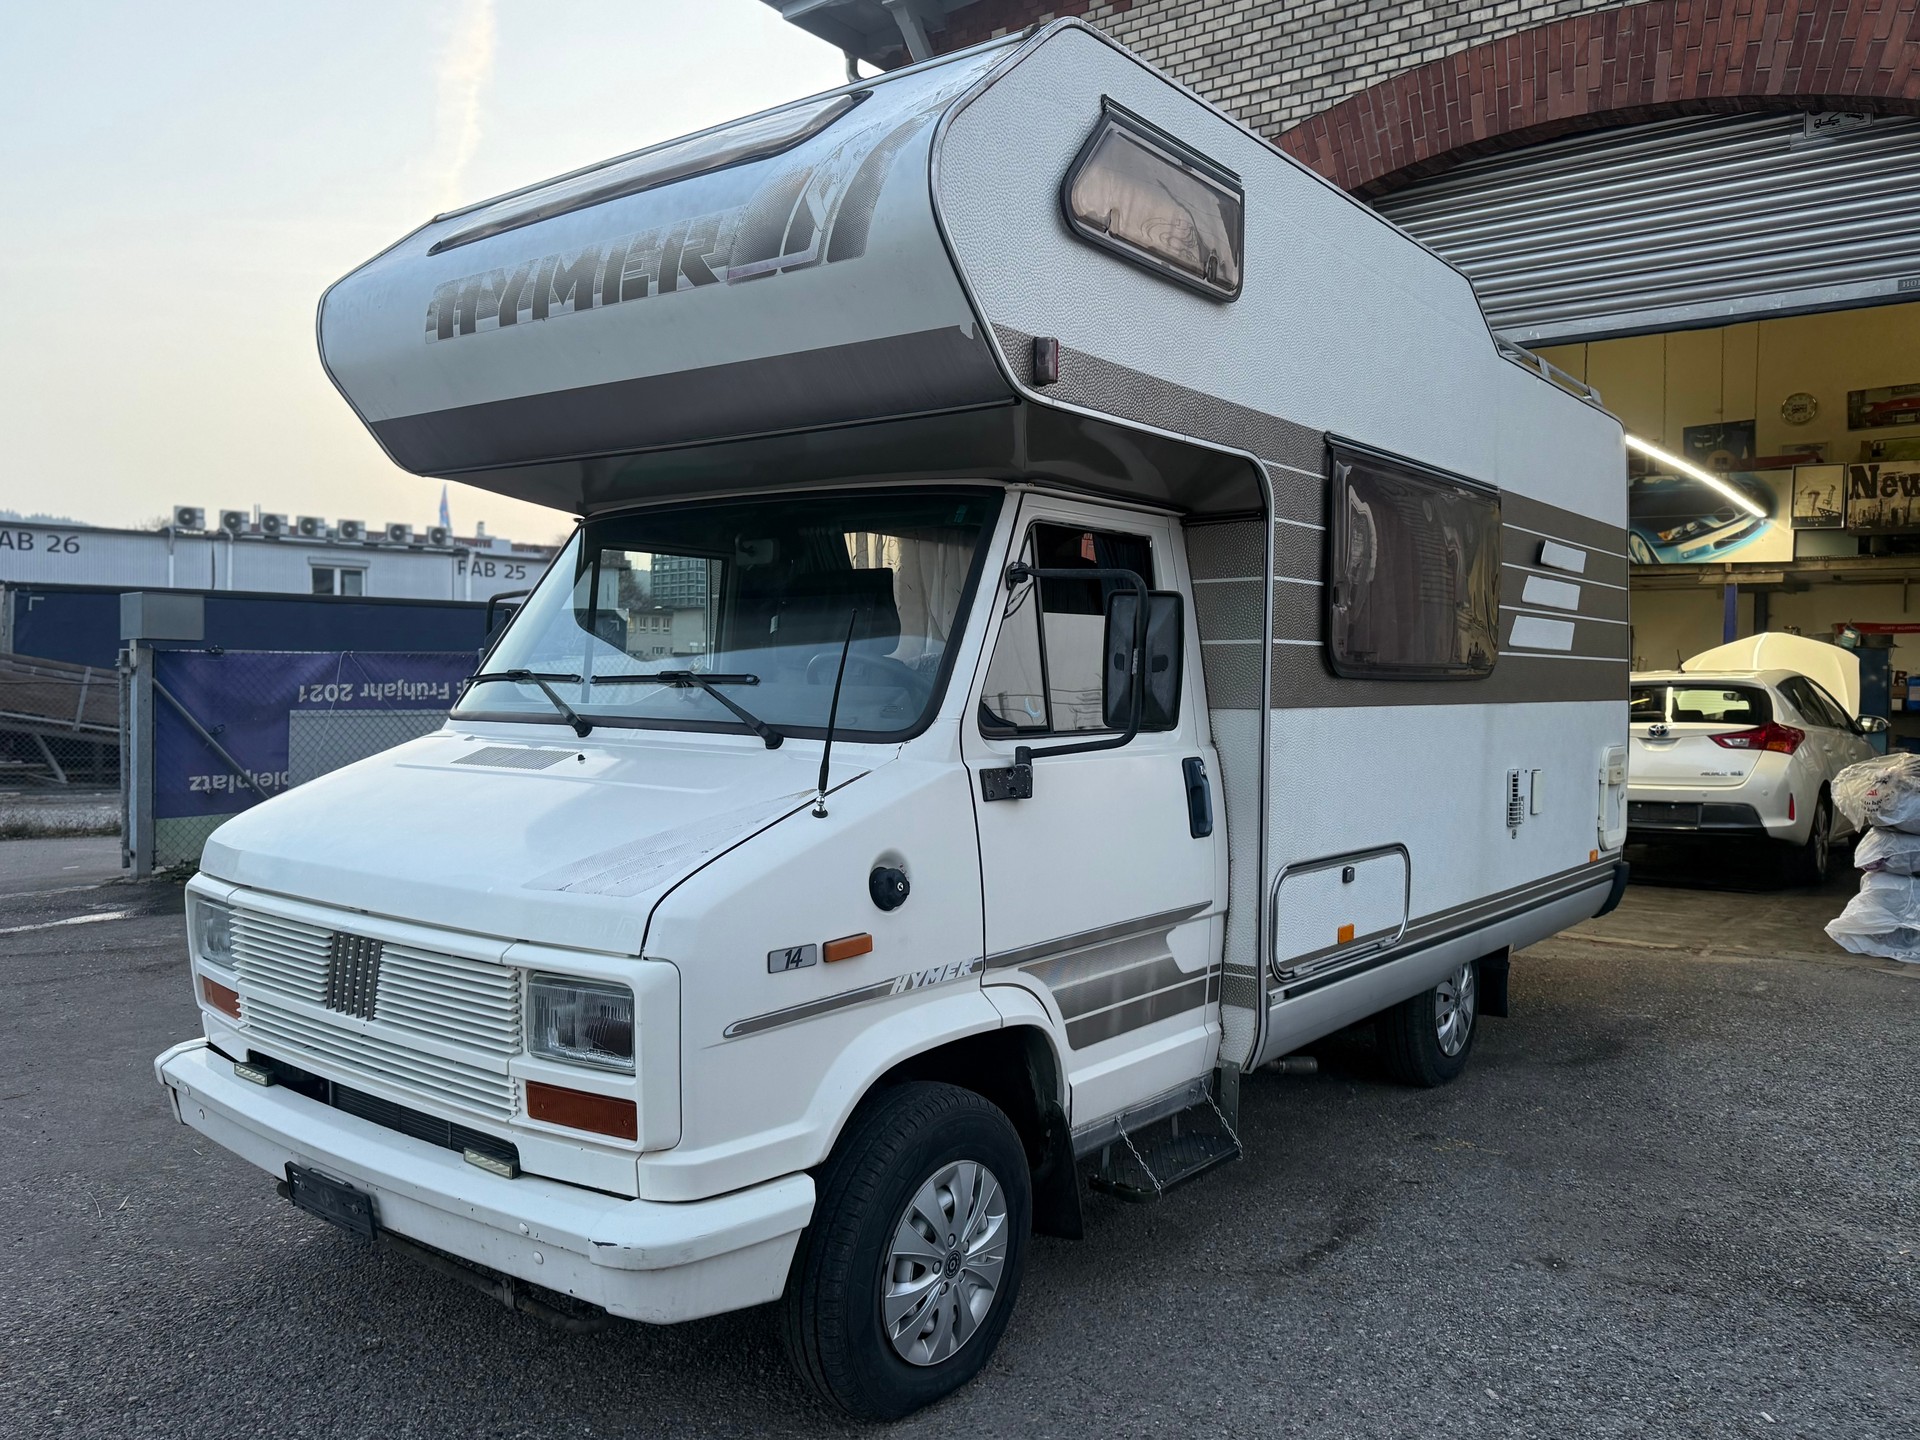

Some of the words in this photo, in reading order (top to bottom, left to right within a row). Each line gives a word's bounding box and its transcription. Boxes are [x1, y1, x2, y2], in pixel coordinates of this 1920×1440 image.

[434, 213, 722, 341] HYMER
[46, 534, 80, 555] 26
[503, 563, 527, 580] 25
[298, 682, 354, 703] 2021
[360, 679, 450, 701] Frühjahr
[784, 947, 803, 969] 14
[889, 957, 975, 996] HYMER
